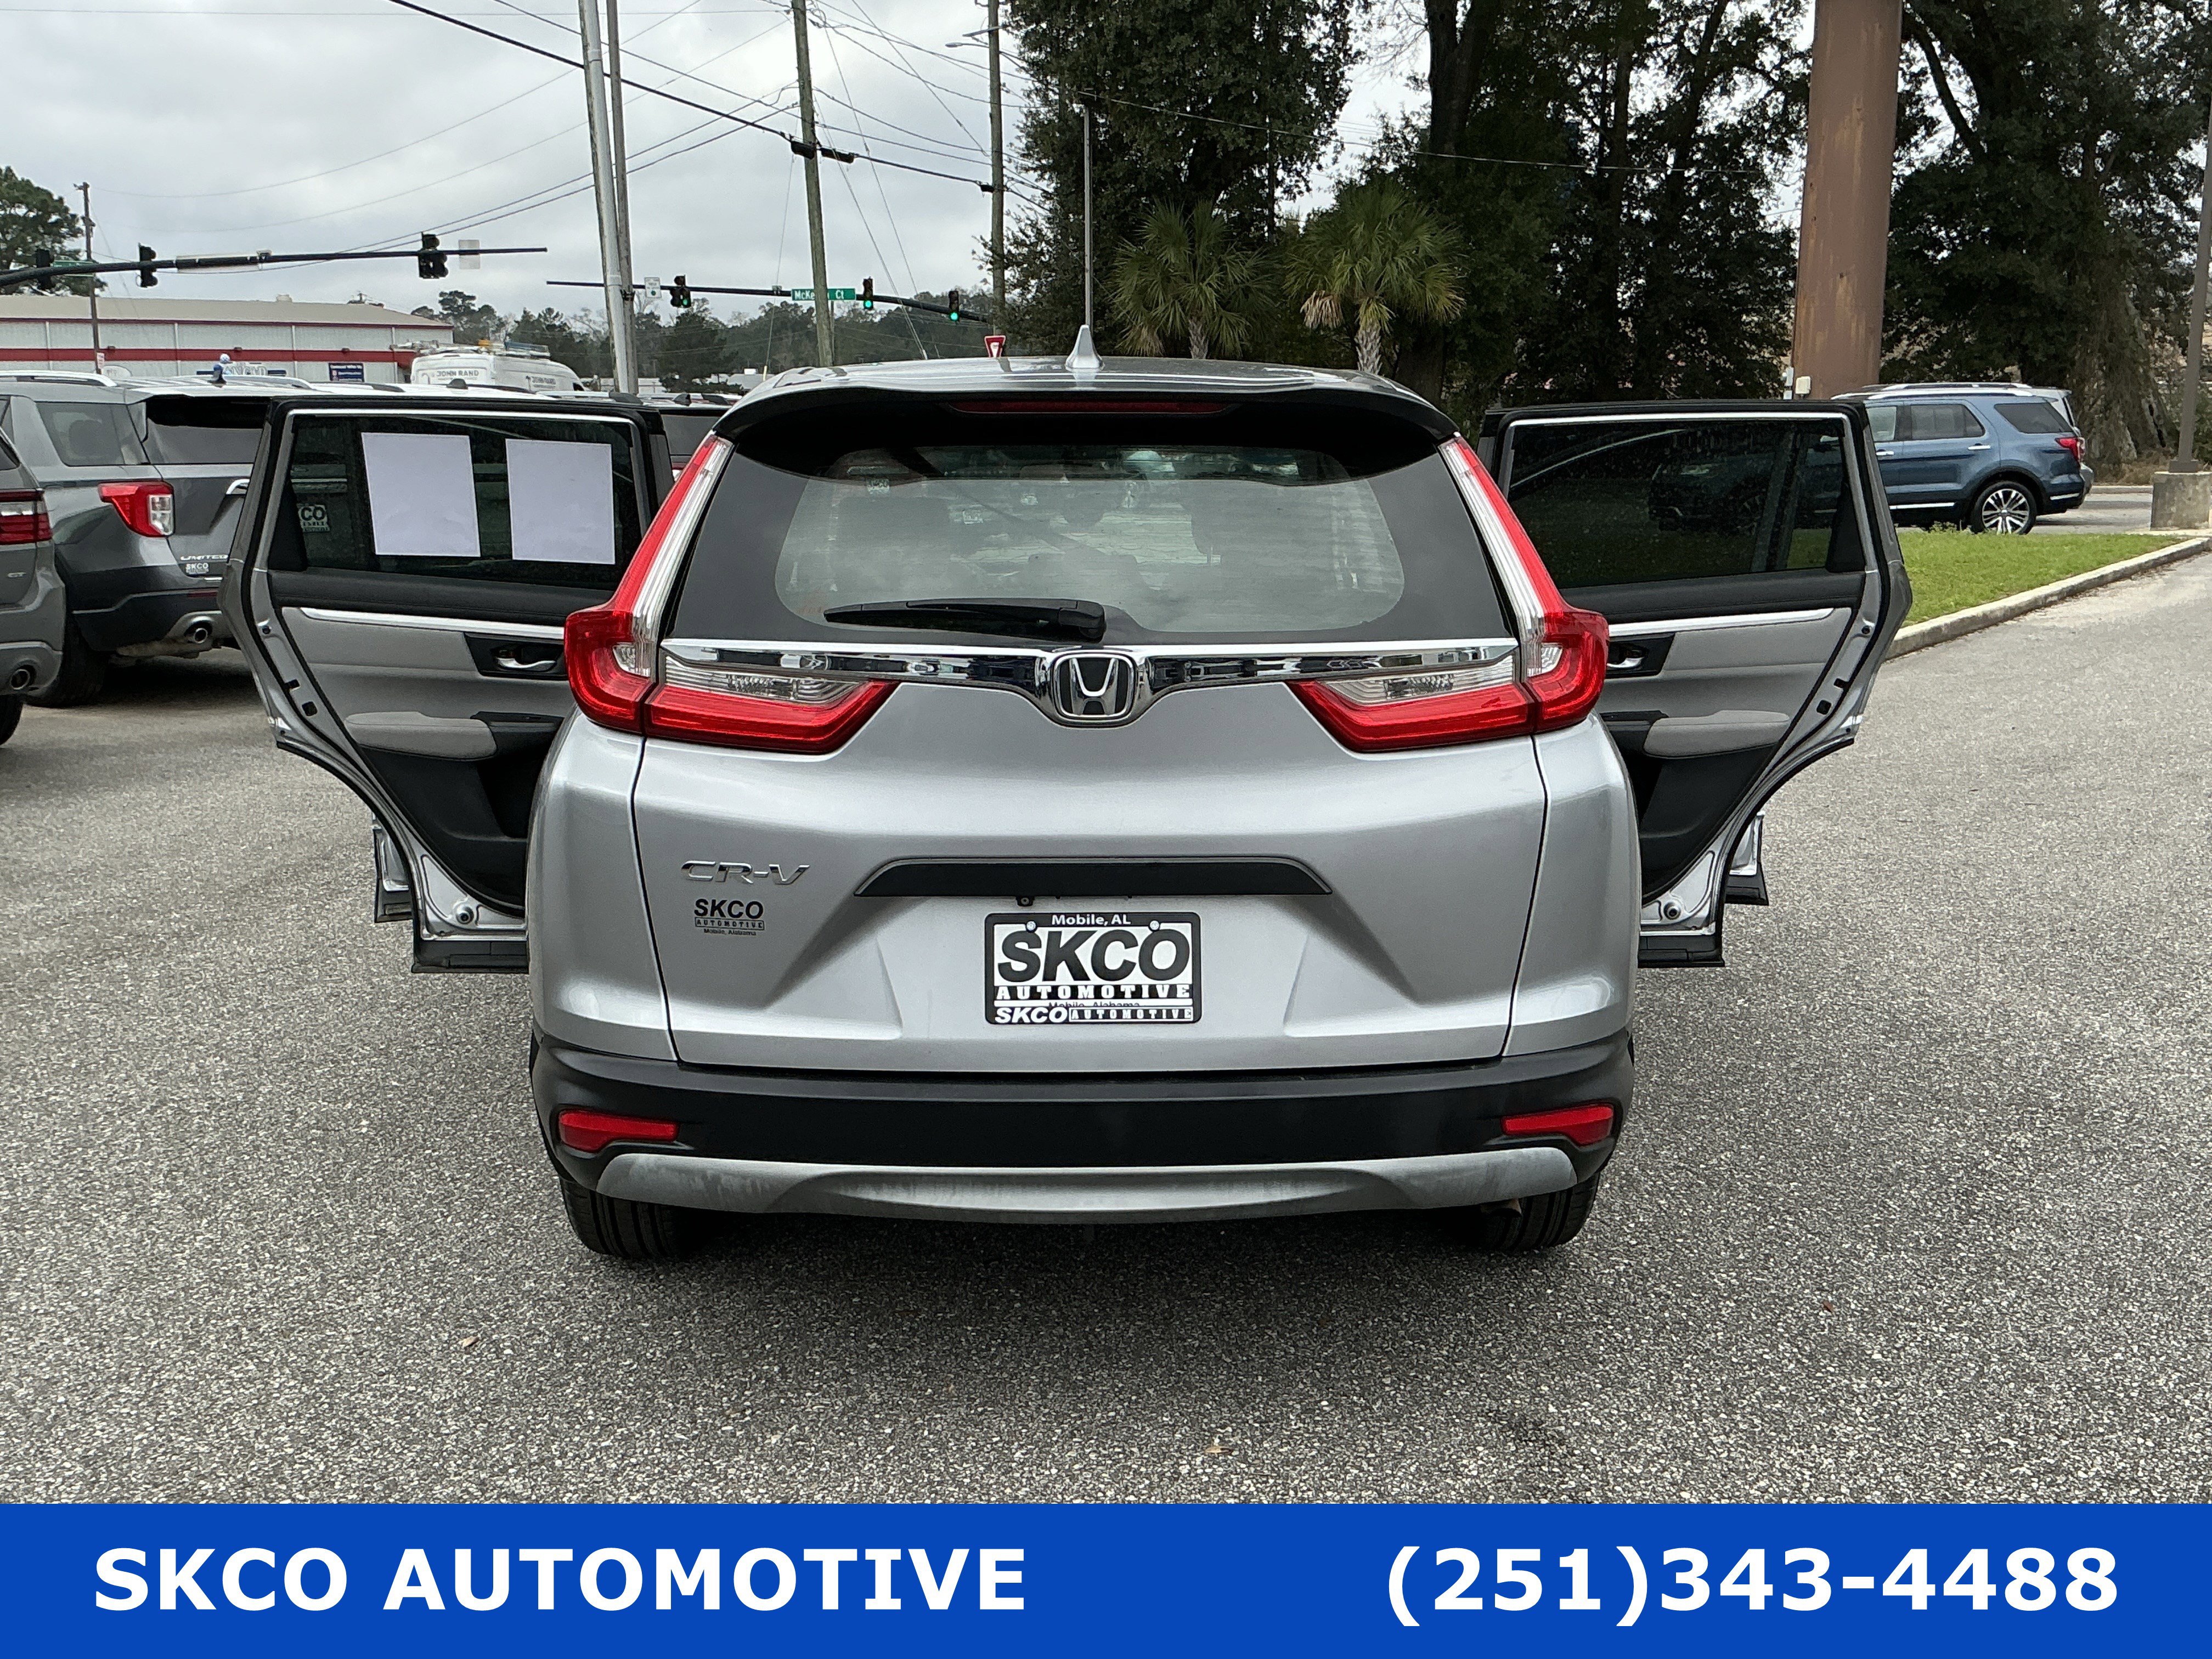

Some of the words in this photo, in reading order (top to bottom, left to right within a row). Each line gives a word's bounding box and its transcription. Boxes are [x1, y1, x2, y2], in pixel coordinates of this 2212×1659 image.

[794, 290, 830, 300] McKe
[836, 290, 844, 300] Ct
[301, 506, 326, 521] CO
[681, 860, 810, 885] CR-V
[694, 898, 764, 919] SKCO
[697, 919, 763, 928] AUTOMOTIVE
[1051, 913, 1109, 926] Mobile,
[1111, 914, 1131, 925] AL
[997, 929, 1190, 983] SKCO
[996, 984, 1190, 1000] AUTOMOTIVE
[995, 1007, 1068, 1023] SKCO
[1071, 1008, 1192, 1019] AUTOMOTIVE
